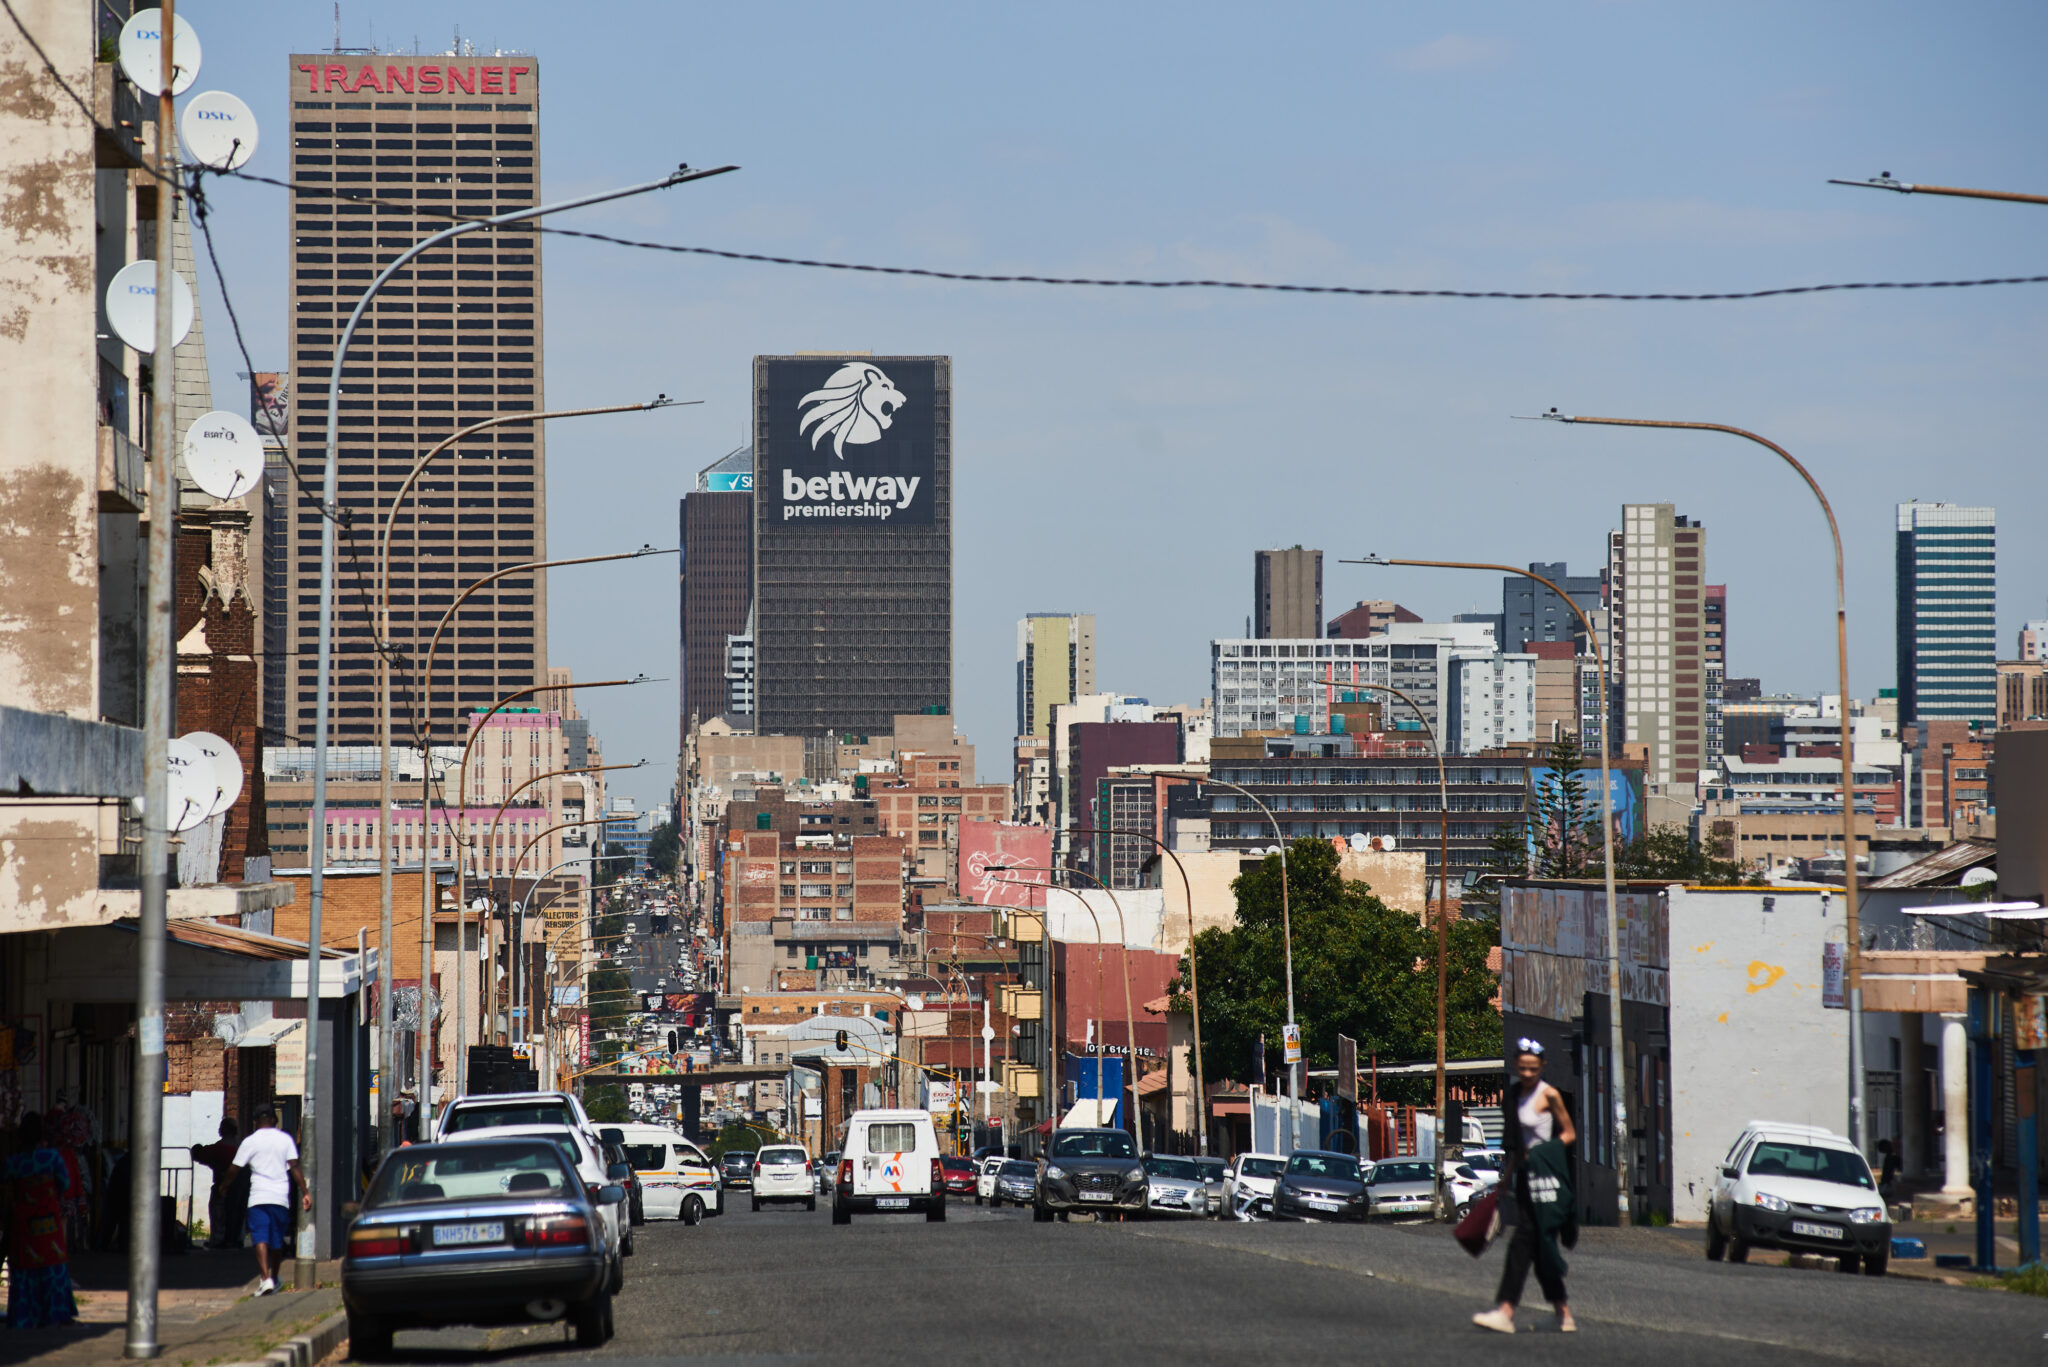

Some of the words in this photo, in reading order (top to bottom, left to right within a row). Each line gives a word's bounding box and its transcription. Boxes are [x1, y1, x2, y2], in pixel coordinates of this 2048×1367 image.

[298, 64, 529, 95] TRANSNET
[198, 111, 236, 120] DStv
[129, 285, 156, 295] DSt
[783, 469, 921, 509] betway
[784, 502, 892, 520] premiership
